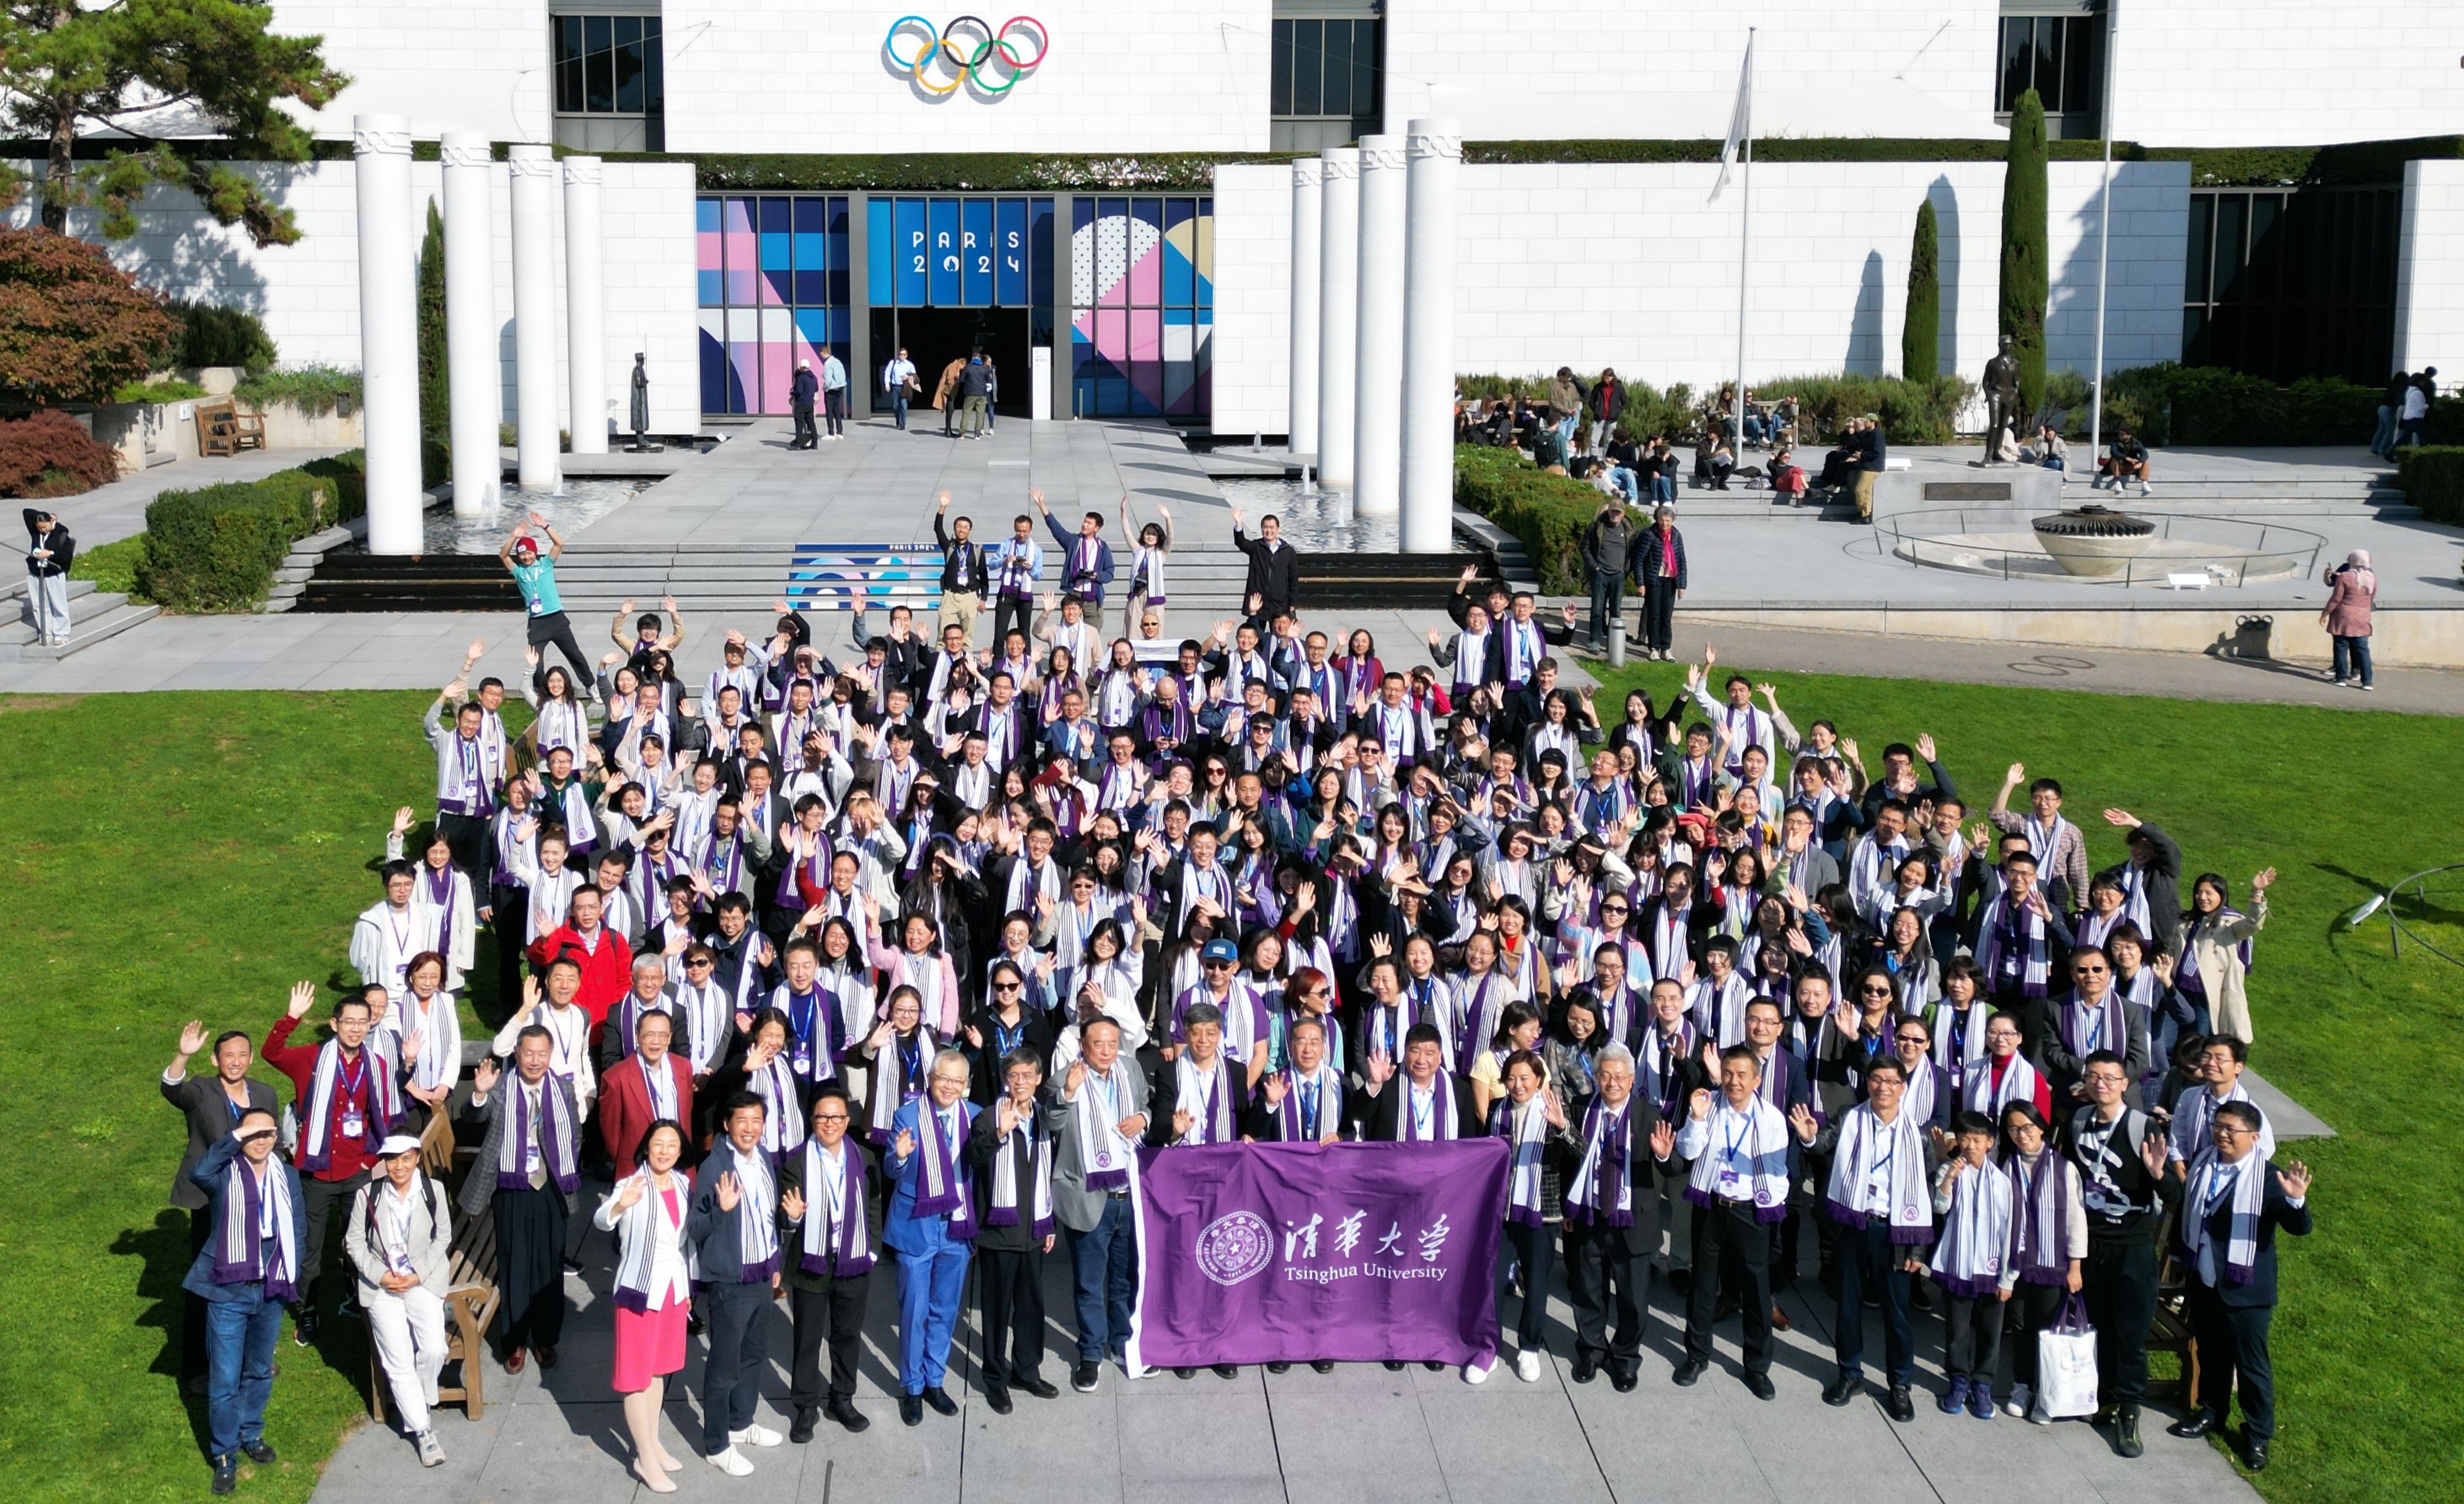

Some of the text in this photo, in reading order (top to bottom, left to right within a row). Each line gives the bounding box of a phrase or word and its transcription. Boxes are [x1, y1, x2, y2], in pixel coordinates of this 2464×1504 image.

[912, 231, 1019, 249] PARIS
[913, 255, 1019, 273] 2024
[1285, 1263, 1447, 1285] Tsinghua University
